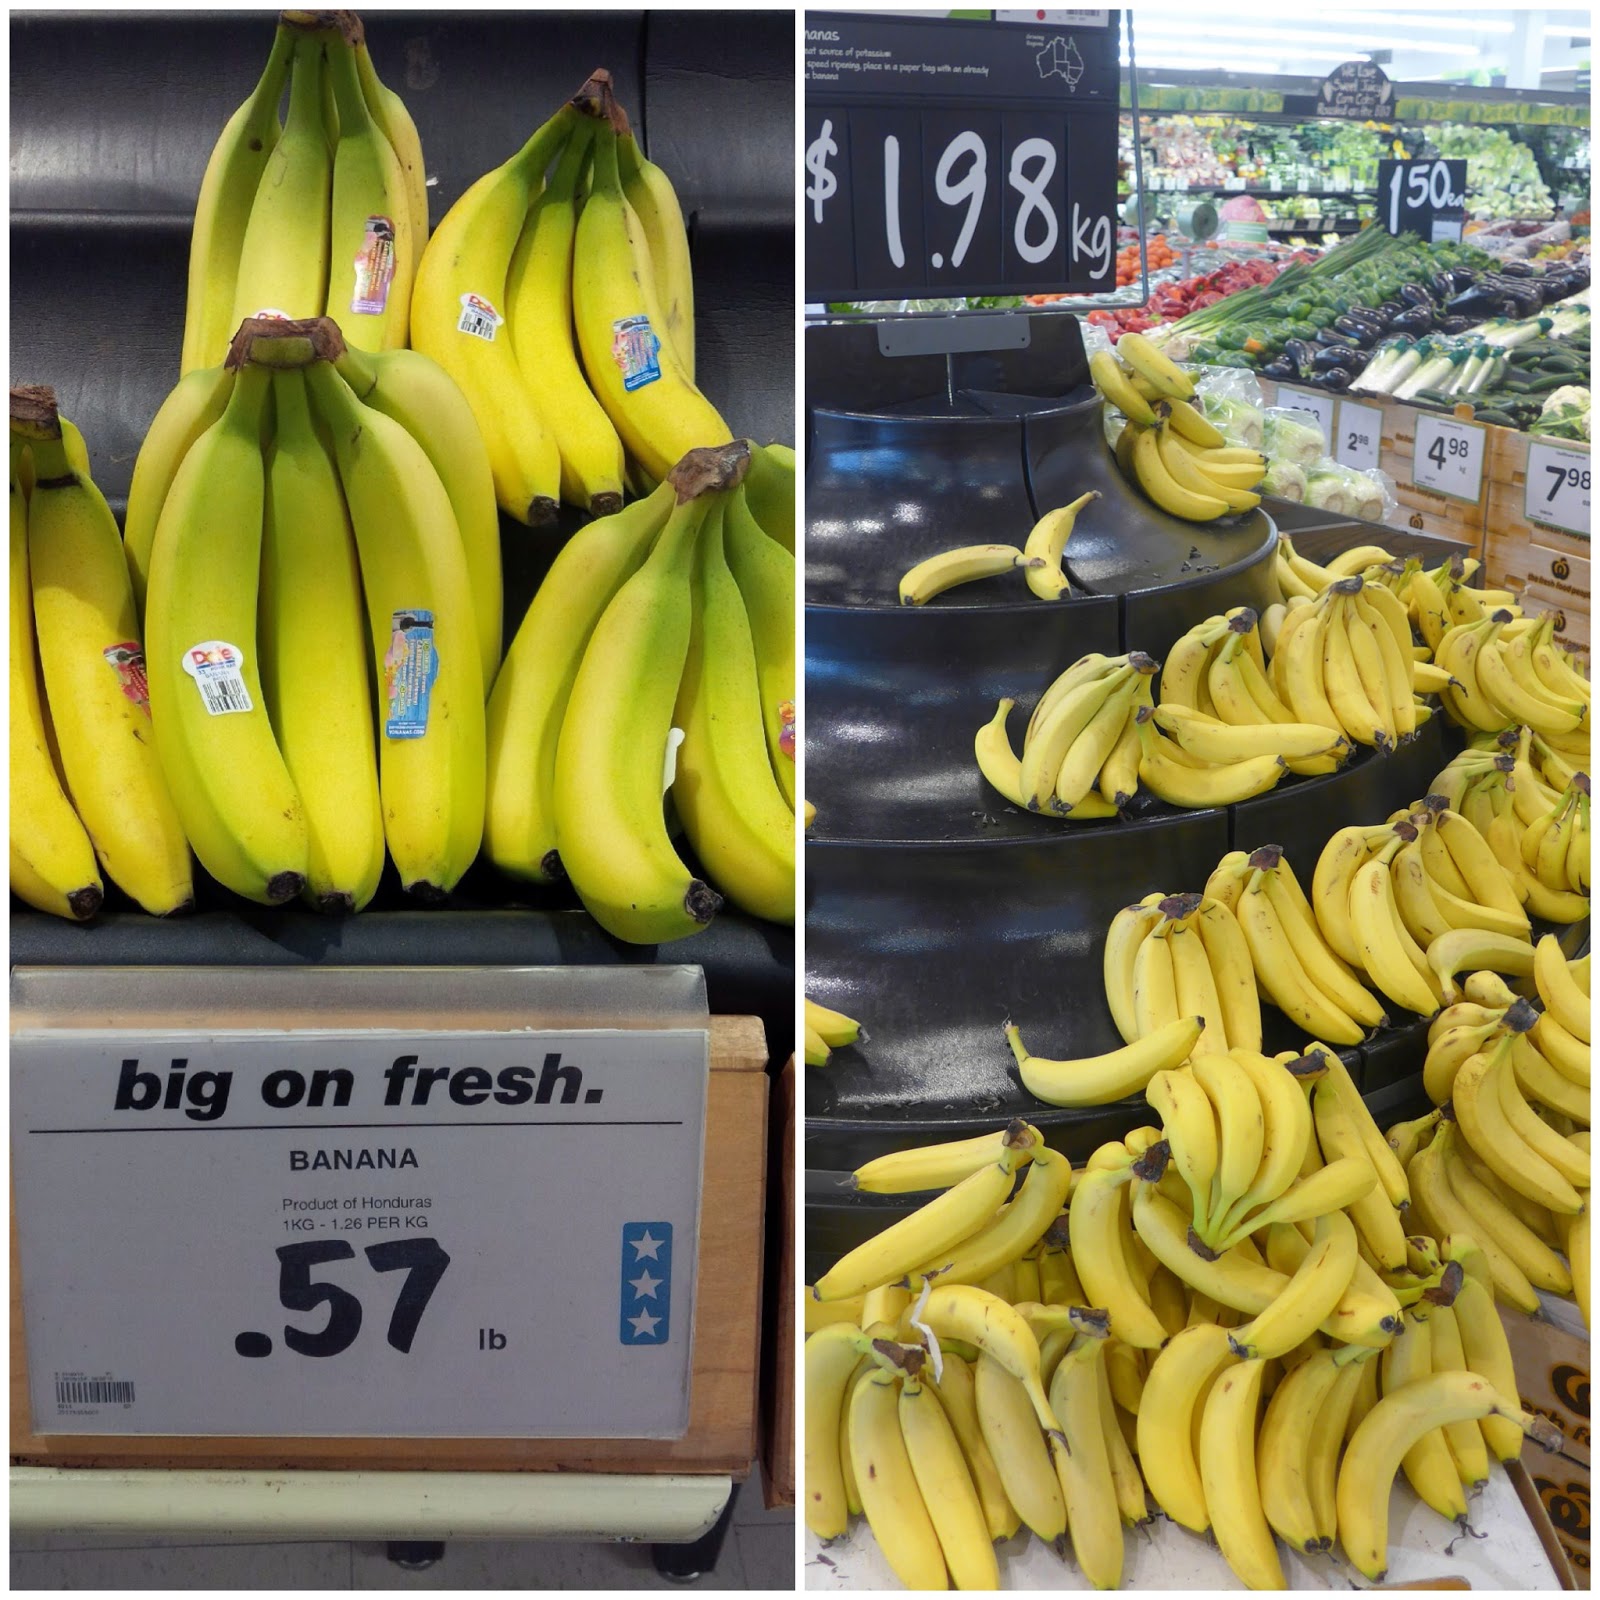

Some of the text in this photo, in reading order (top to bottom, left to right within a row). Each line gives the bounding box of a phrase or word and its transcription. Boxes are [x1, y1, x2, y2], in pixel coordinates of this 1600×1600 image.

[818, 48, 843, 56] source
[845, 47, 854, 56] of
[855, 49, 891, 59] potassium
[807, 60, 829, 70] speed
[863, 62, 882, 72] place
[899, 64, 921, 74] paper
[922, 63, 936, 74] bag
[937, 65, 952, 73] with
[963, 65, 989, 77] already
[812, 71, 839, 80] banana
[806, 119, 1111, 280] $ 1.98 kg
[1528, 572, 1540, 582] the
[1539, 576, 1555, 588] fresh
[1556, 581, 1572, 593] food
[191, 648, 233, 667] Doe
[114, 1053, 604, 1122] big on fresh.
[289, 1148, 419, 1171] BANANA
[282, 1196, 432, 1211] Product of Honduras
[283, 1218, 315, 1231] 1KG
[331, 1217, 362, 1230] 1.26
[367, 1216, 400, 1229] PER
[405, 1216, 428, 1228] KG
[235, 1237, 508, 1358] .57 lb
